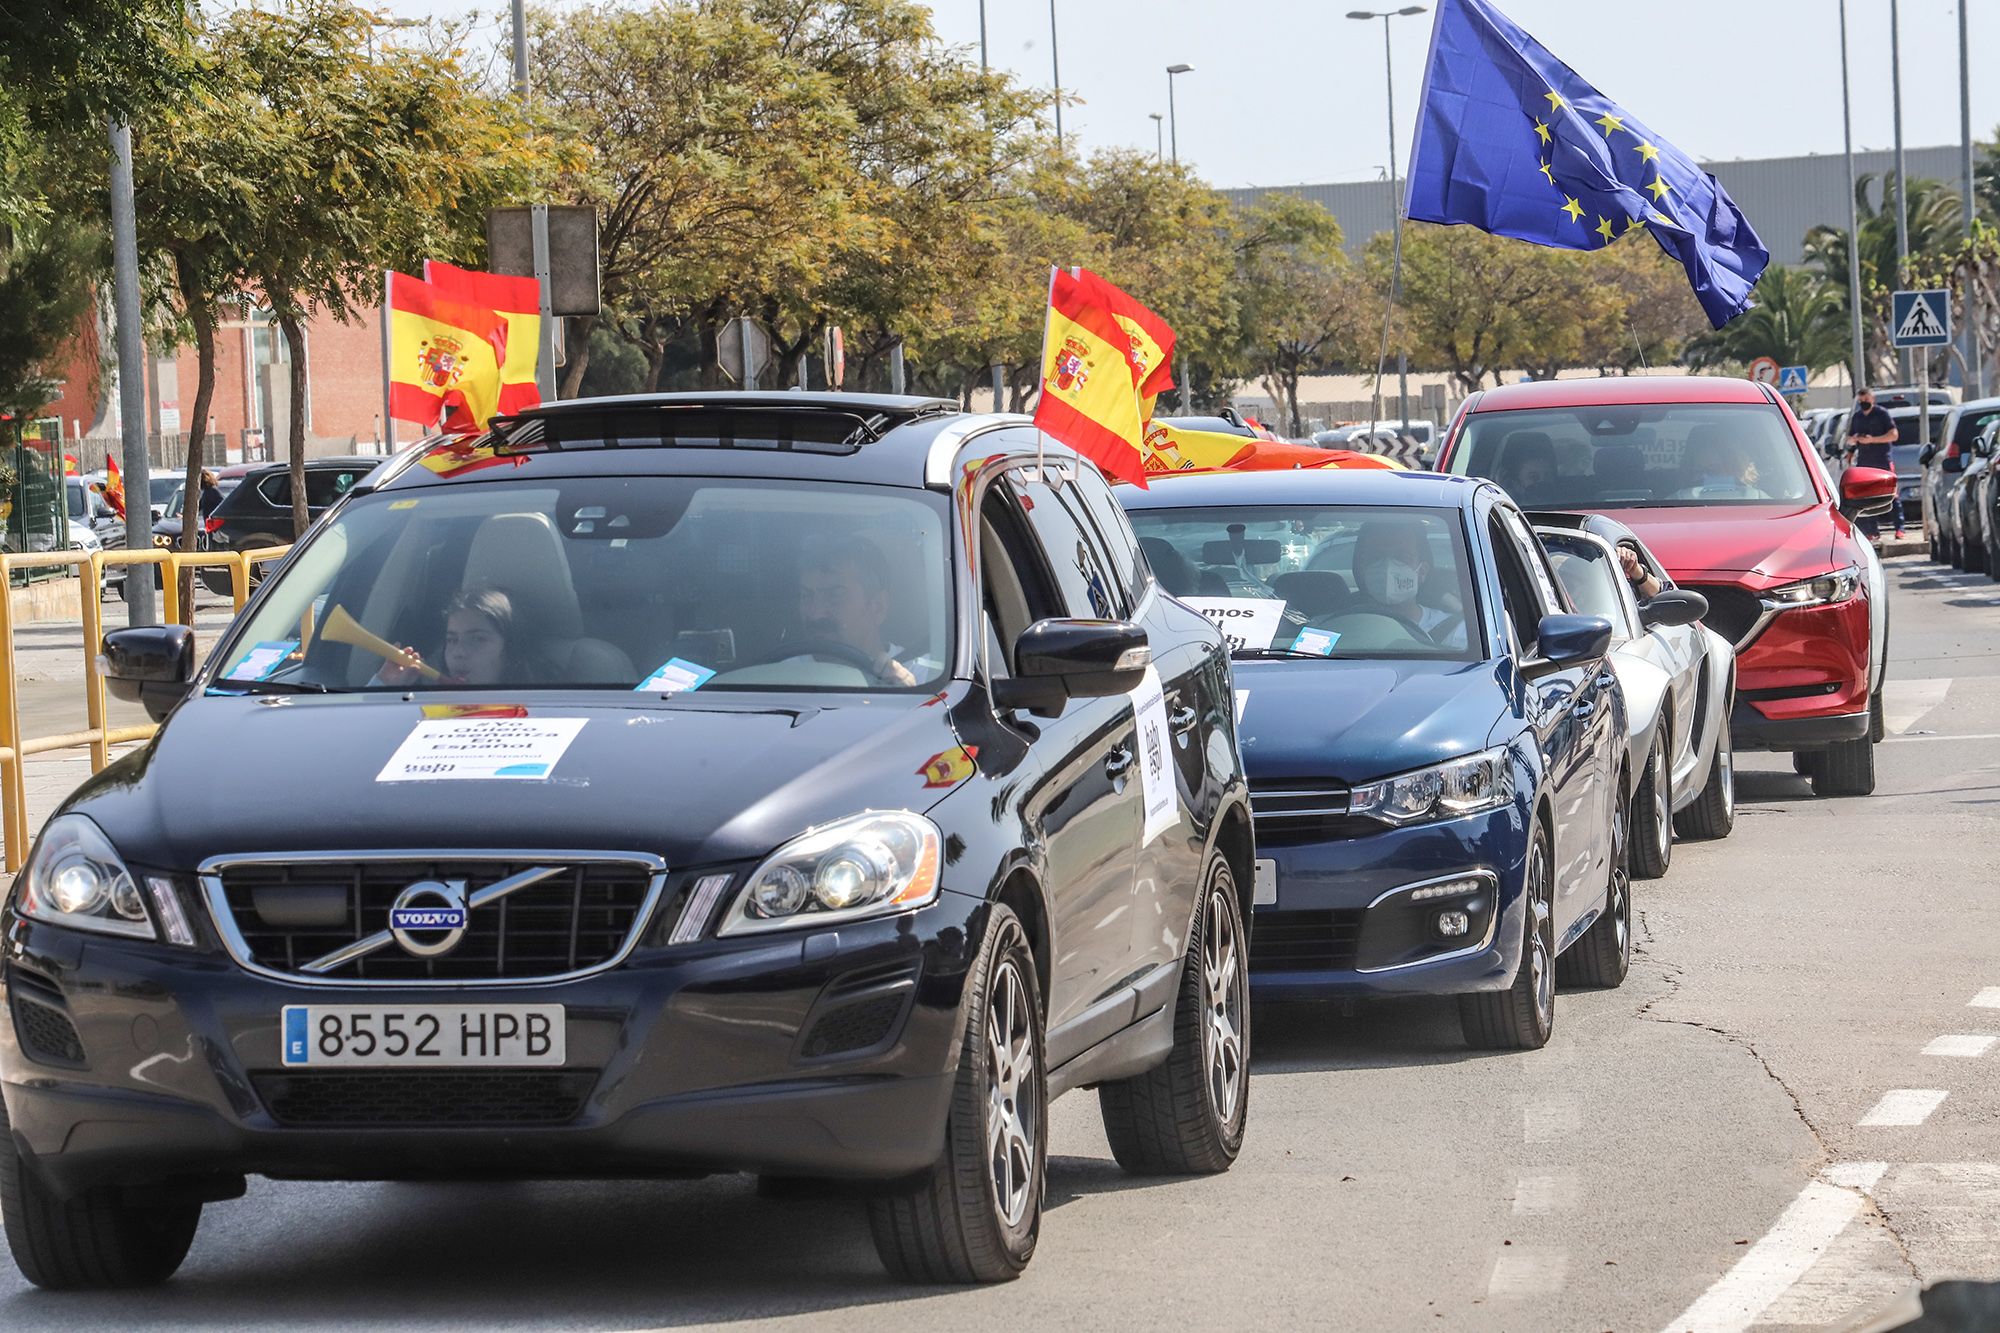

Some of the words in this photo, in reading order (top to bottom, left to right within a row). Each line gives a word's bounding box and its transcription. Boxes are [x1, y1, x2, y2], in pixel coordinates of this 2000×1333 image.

[395, 913, 460, 924] VOLVO
[318, 1013, 441, 1057] 8552
[460, 1013, 552, 1057] HPB
